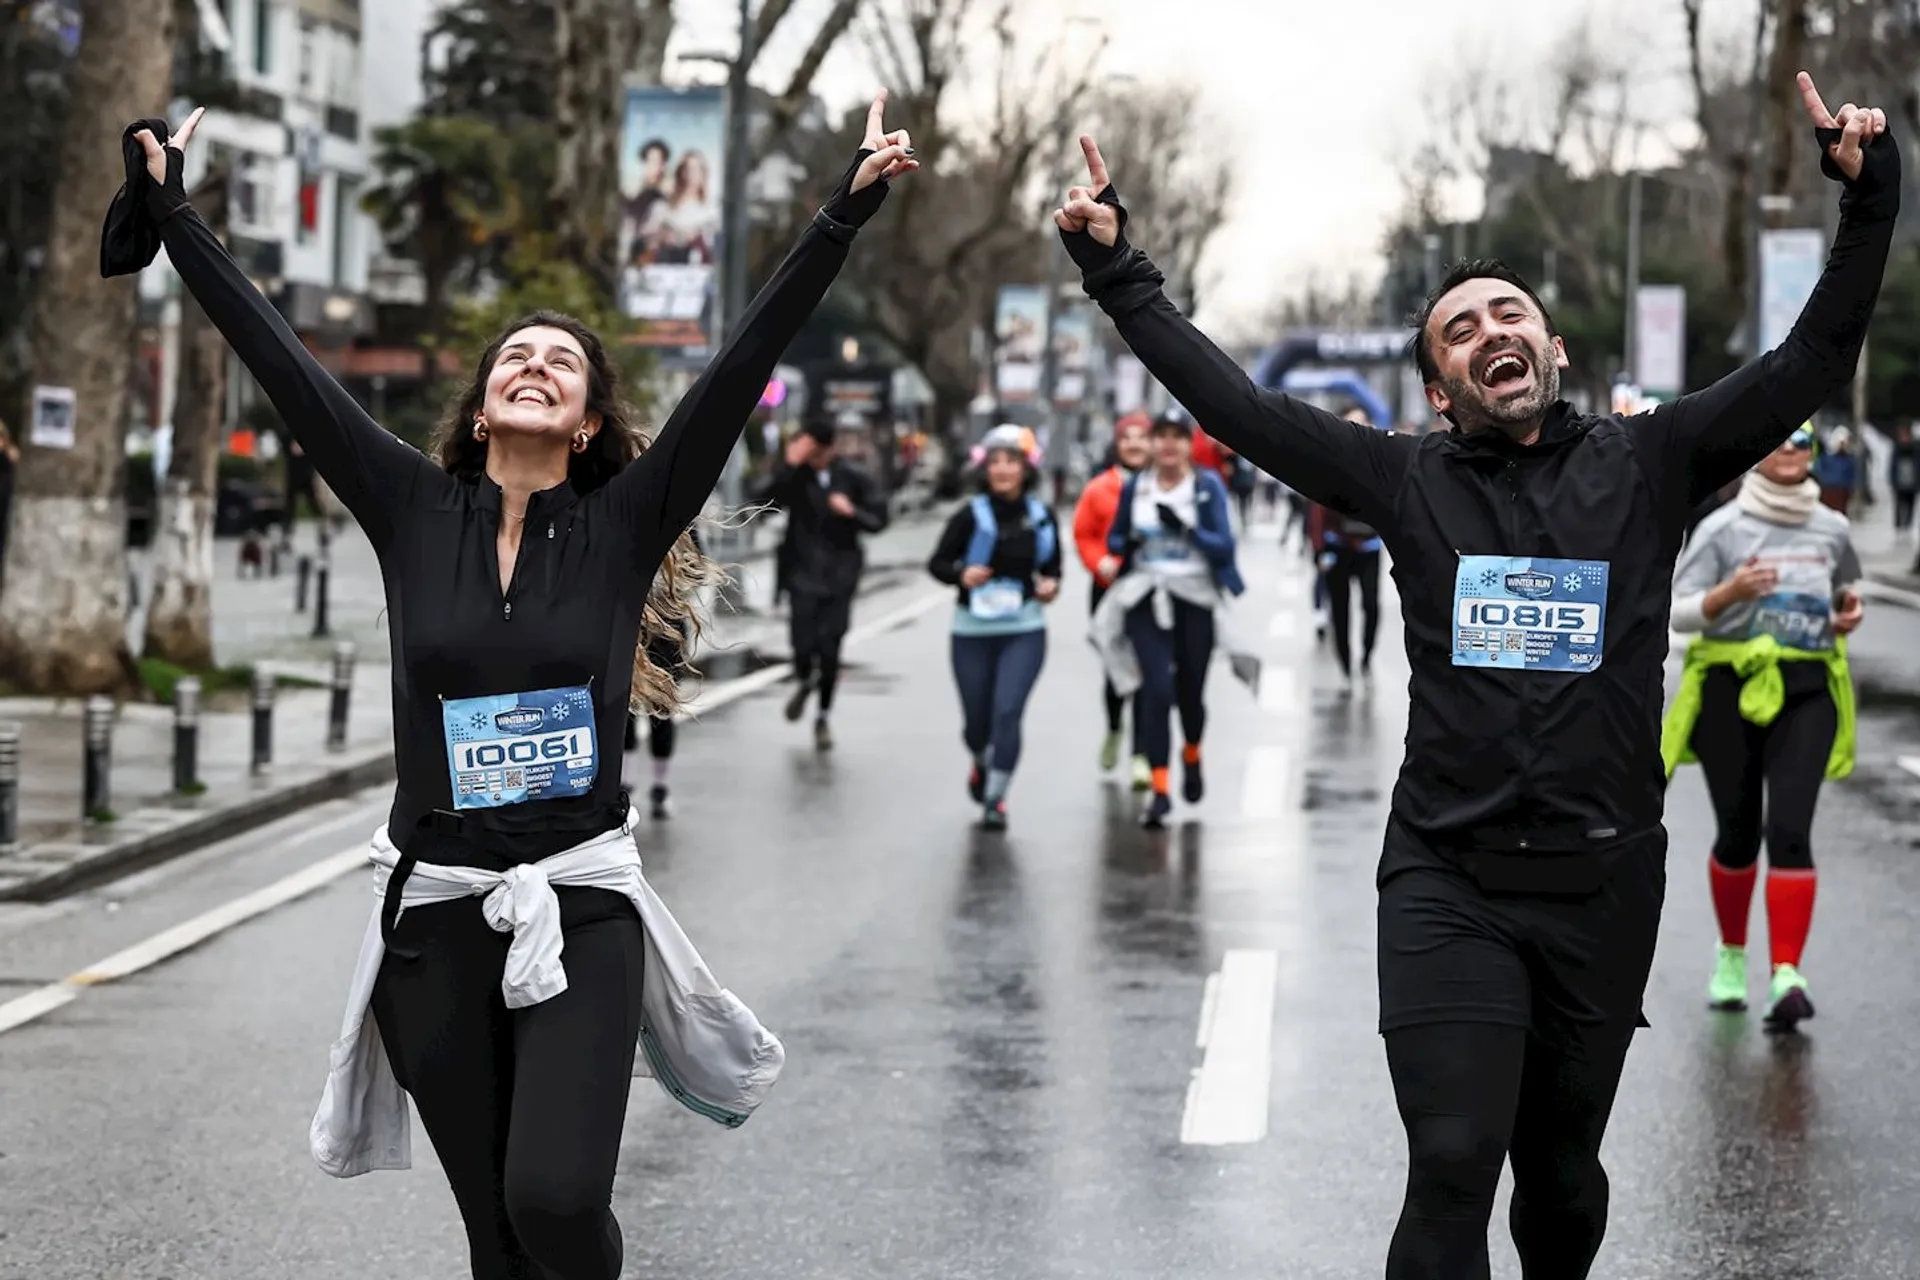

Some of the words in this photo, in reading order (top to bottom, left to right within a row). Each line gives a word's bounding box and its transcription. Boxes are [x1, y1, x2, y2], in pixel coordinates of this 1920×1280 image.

[1507, 578, 1534, 587] WINTER
[1535, 579, 1551, 588] RUN
[1470, 603, 1585, 629] 10815
[1526, 648, 1551, 656] WINTER
[497, 714, 525, 726] WINTER
[525, 713, 541, 723] RUN
[465, 734, 578, 768] 10061
[526, 772, 554, 781] BIGGEST
[527, 780, 551, 788] WINTER
